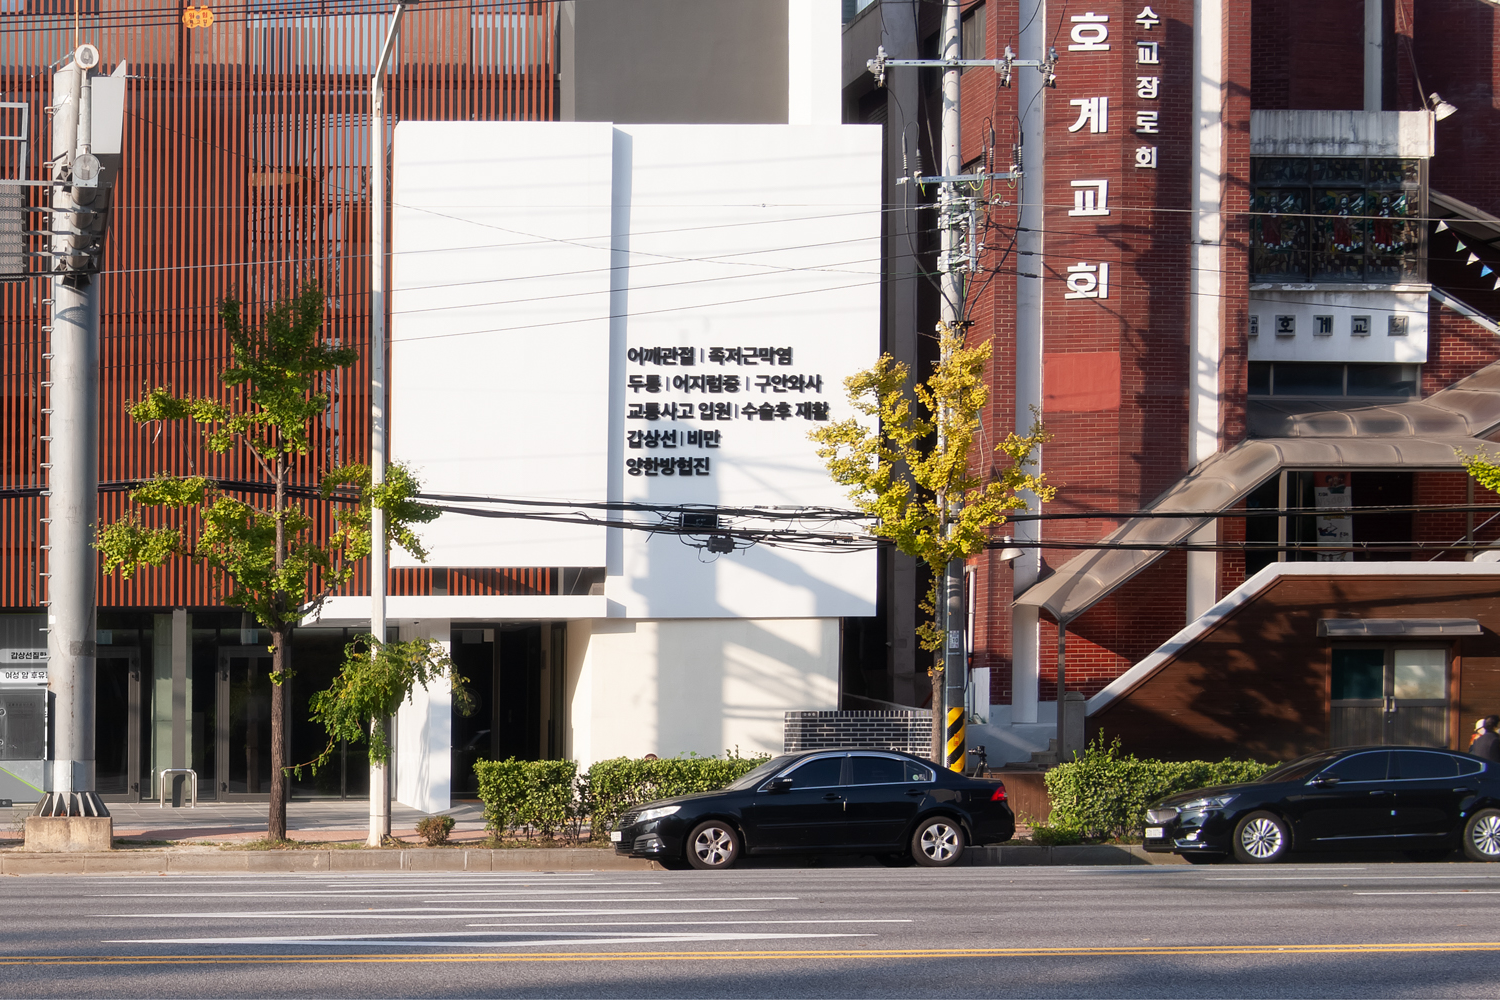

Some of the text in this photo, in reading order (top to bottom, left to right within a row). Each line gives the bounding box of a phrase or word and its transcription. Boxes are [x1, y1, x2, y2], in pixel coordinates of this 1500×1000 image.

[1064, 12, 1111, 300] 호계교회
[627, 347, 793, 366] 어깨관절 족저근막염
[627, 374, 823, 393] 두통 어지럼증 구안와사
[627, 402, 829, 421] 교통사고 입원 수술후 재활
[627, 429, 722, 449] 갑상선 비만
[626, 457, 710, 477] 양한방협진
[5, 671, 19, 679] 여성
[31, 671, 47, 679] 후유
